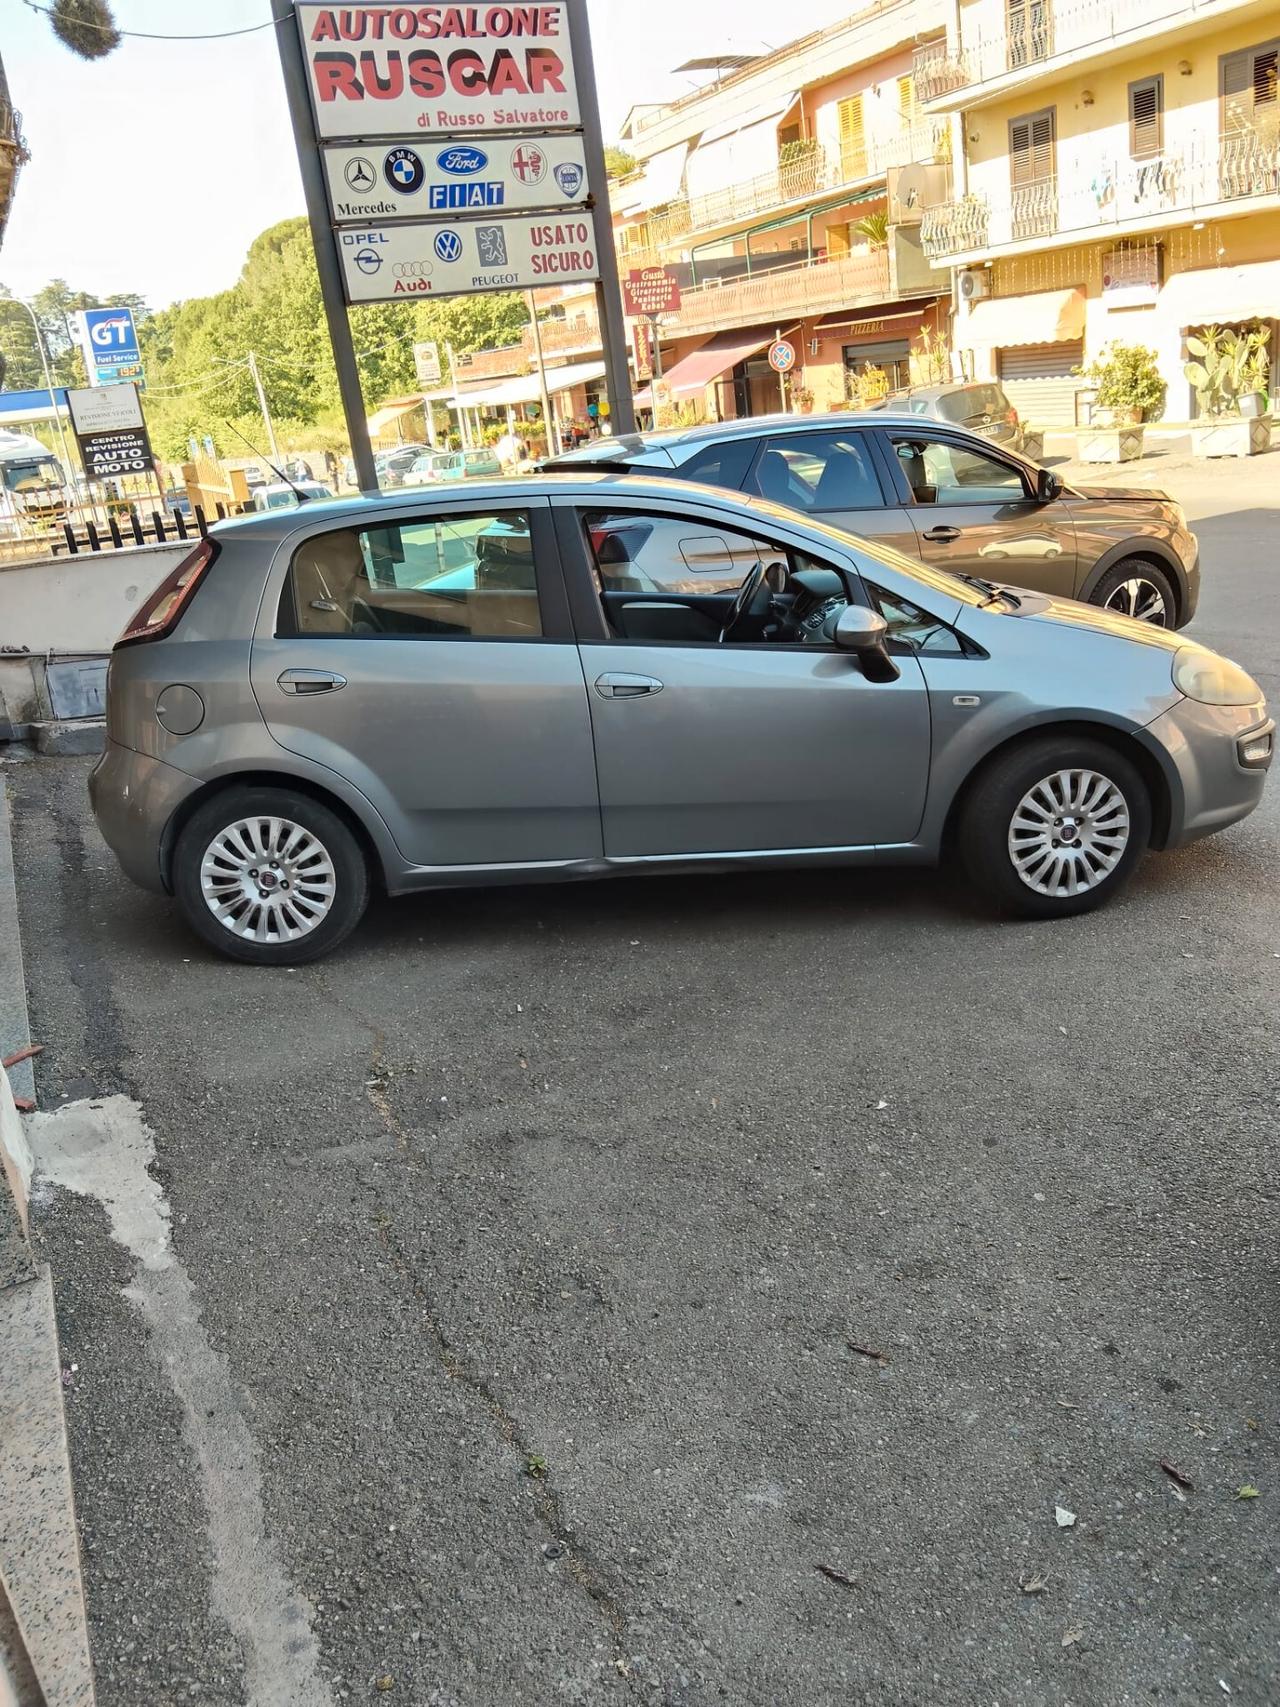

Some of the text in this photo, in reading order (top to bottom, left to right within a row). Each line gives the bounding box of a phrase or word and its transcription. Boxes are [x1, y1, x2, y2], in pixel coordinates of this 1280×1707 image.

[311, 6, 560, 41] AUTOSALONE
[313, 48, 567, 102] RUSCAR
[417, 108, 569, 128] di Russo Salvatore
[388, 150, 417, 163] BMW
[445, 151, 480, 169] Ford
[431, 182, 503, 208] FIAT
[337, 201, 397, 216] Mercedes
[342, 232, 390, 245] OPEL
[530, 222, 588, 247] USATO
[531, 250, 594, 274] SICURO
[393, 279, 432, 293] Audi
[472, 273, 520, 286] PEUGEOT
[91, 319, 130, 346] GT
[850, 321, 885, 335] PIZZERIA
[97, 353, 138, 363] Fuel Service
[85, 440, 144, 452] REVISIONE
[91, 434, 135, 444] CENTRO
[92, 448, 142, 462] AUTO
[93, 460, 145, 475] MOTO
